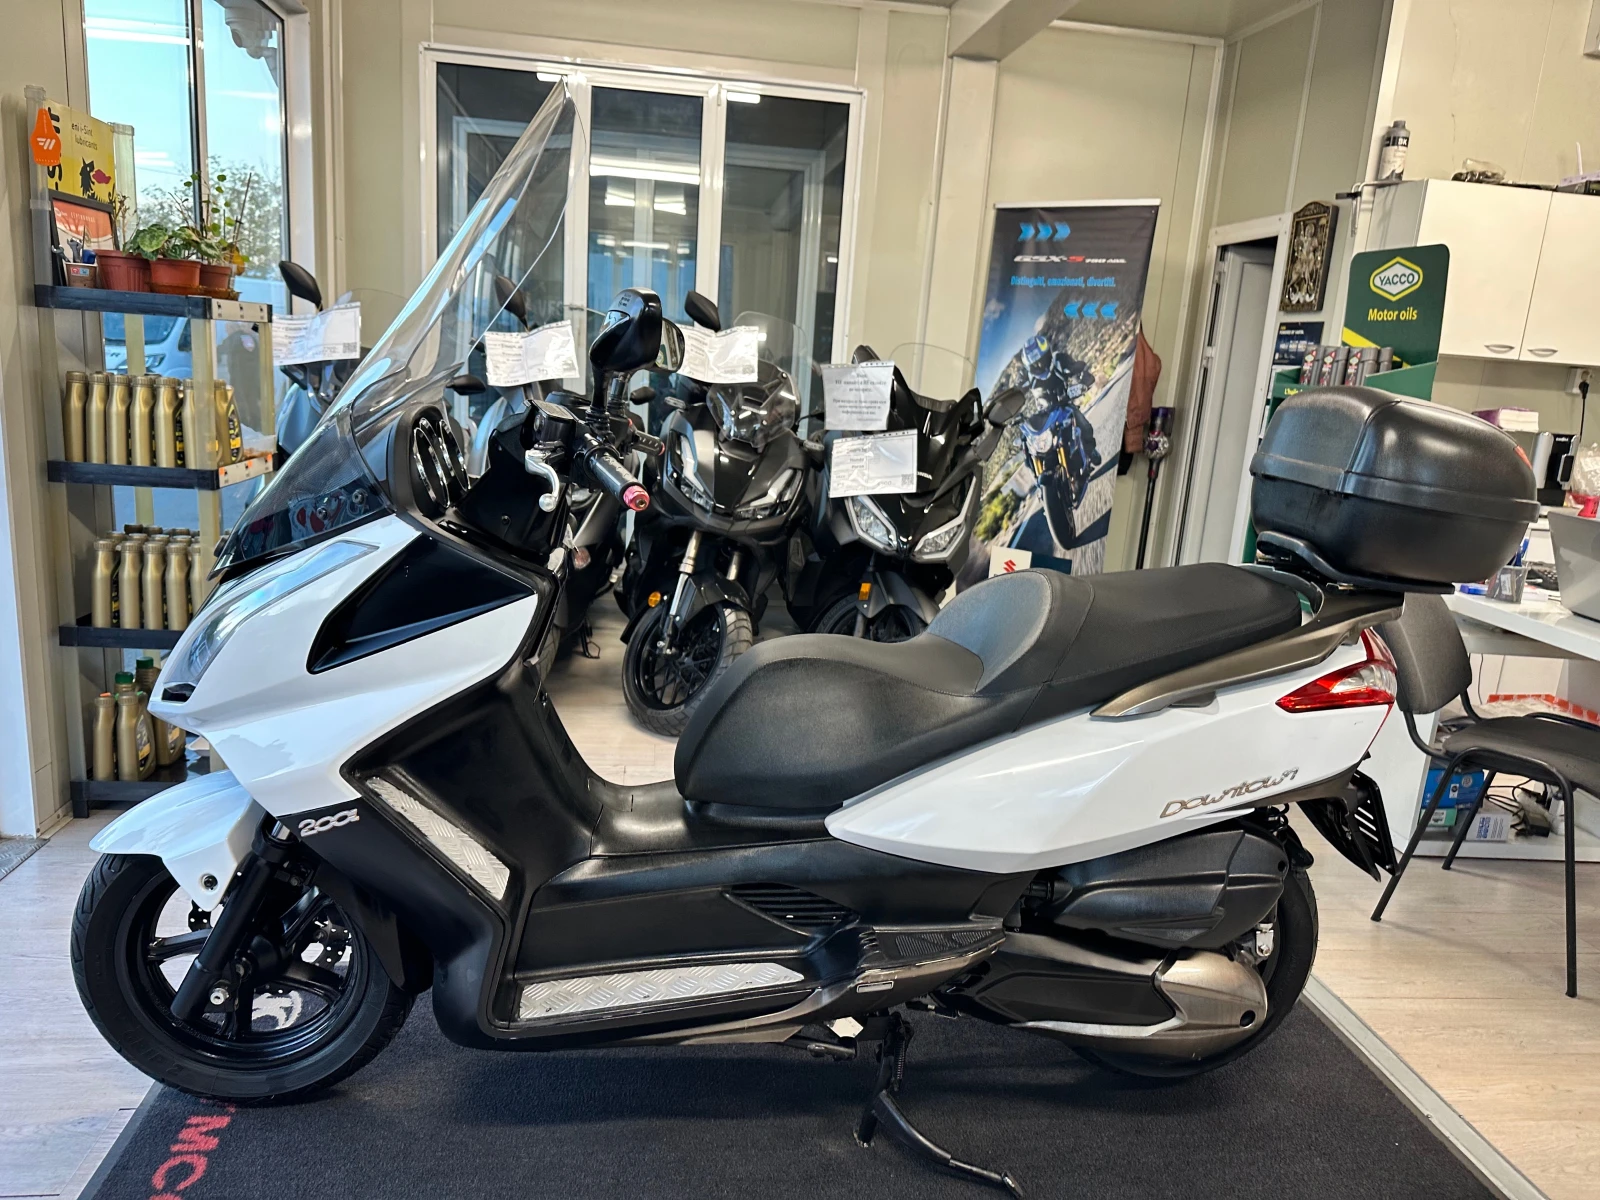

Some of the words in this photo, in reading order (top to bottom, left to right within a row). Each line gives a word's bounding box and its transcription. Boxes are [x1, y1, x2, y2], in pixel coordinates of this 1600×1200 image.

[75, 133, 98, 151] lubricants
[1378, 272, 1415, 286] YACCO
[1367, 308, 1398, 321] Motor
[1399, 306, 1418, 320] oils
